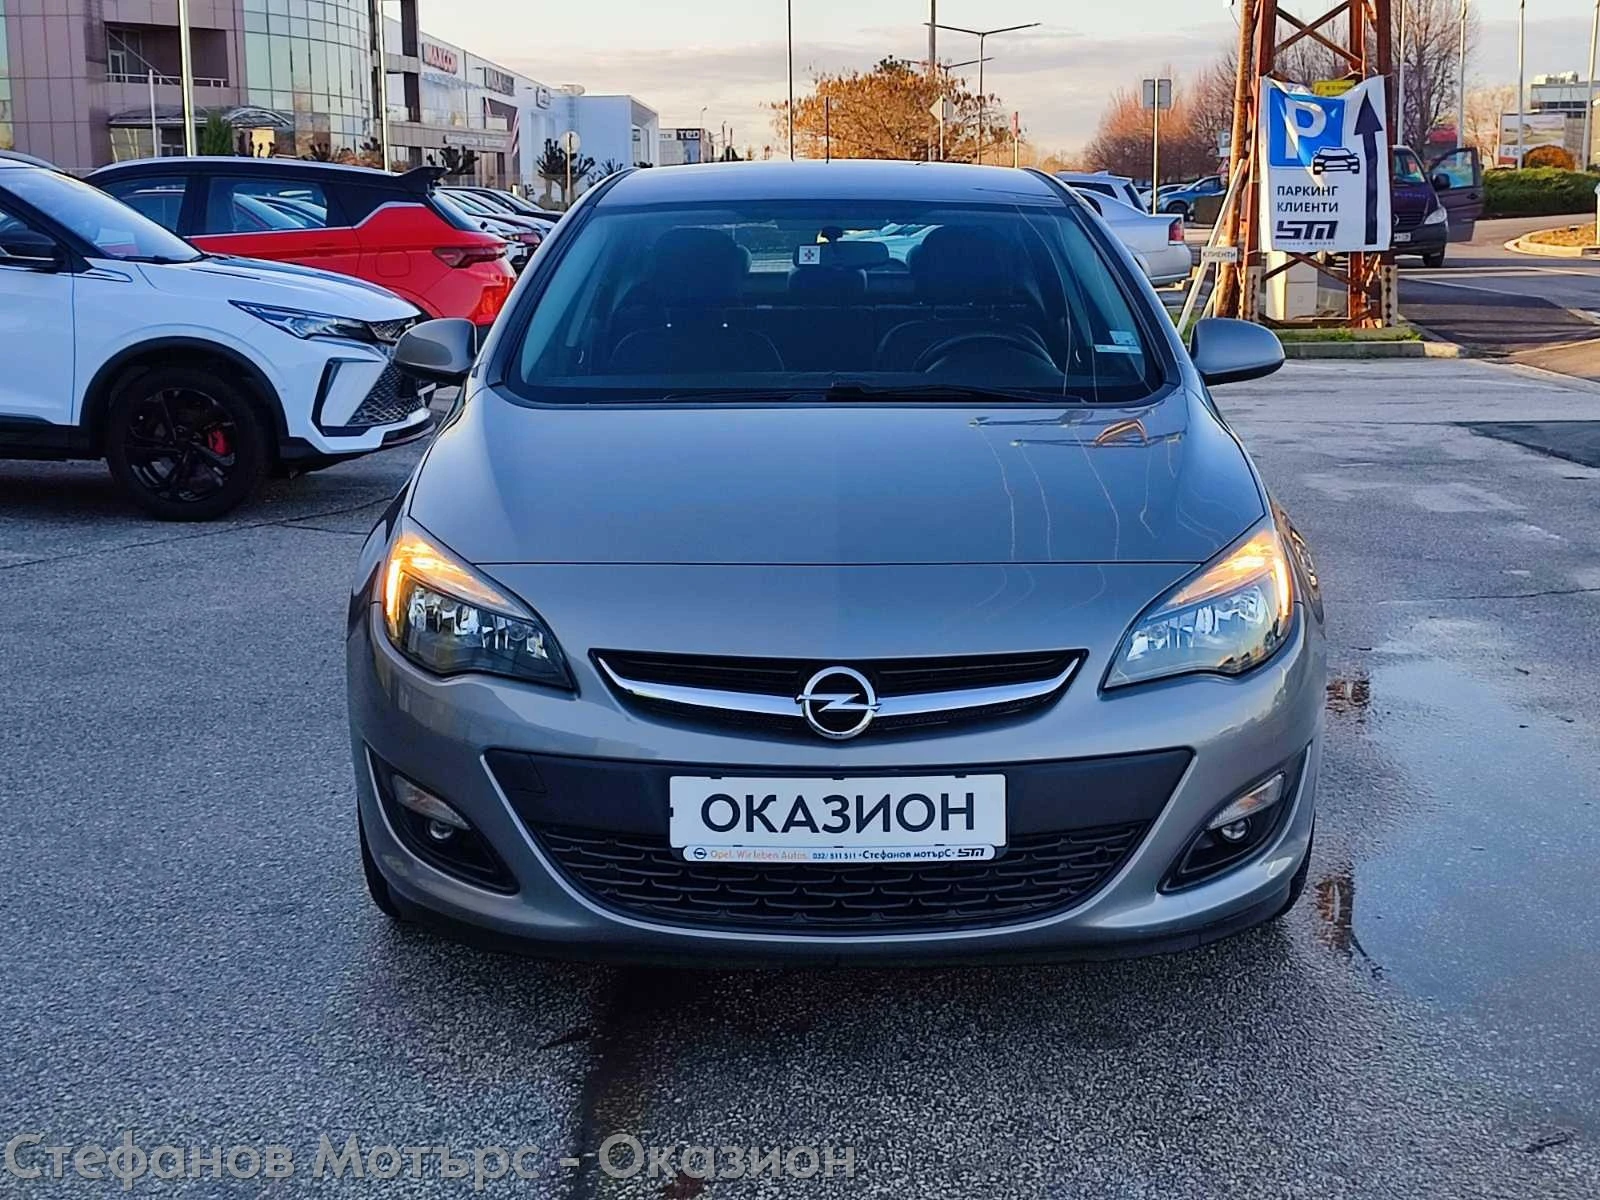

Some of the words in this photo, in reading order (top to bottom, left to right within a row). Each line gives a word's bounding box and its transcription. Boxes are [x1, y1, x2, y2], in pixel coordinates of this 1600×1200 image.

[1285, 98, 1327, 159] P
[1277, 185, 1339, 197] ПАРКИНГ
[1277, 202, 1339, 213] КЛИЕНТИ
[700, 792, 975, 834] ОКАЗИОН
